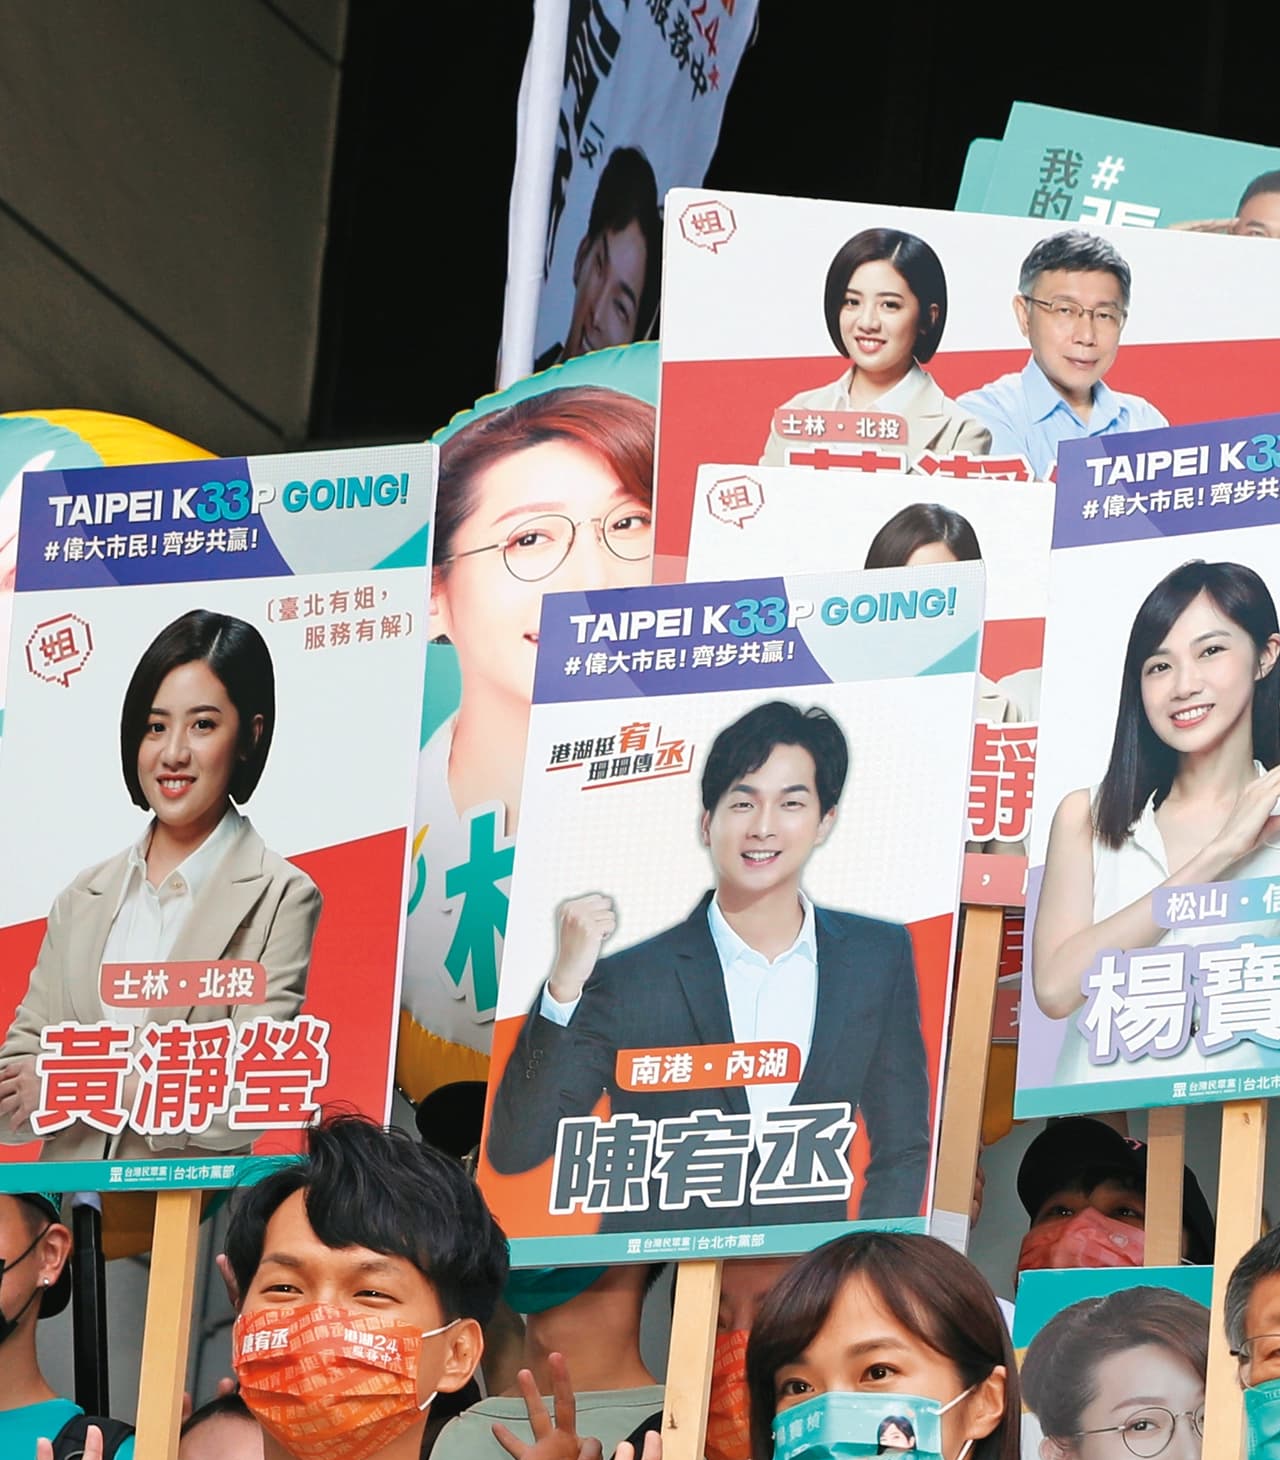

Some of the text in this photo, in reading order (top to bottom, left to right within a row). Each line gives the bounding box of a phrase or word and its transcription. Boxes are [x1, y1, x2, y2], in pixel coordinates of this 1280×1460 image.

[780, 411, 901, 441] 士林・北投
[1086, 445, 1210, 487] TAIPEI
[48, 487, 165, 528] TAIPEI
[282, 473, 410, 514] GOING!
[569, 607, 694, 645] TAIPEI
[820, 586, 958, 628] GOING!
[112, 968, 257, 1002] 士林・北投
[32, 1016, 332, 1136] 黃瀞瑩
[547, 1101, 860, 1216] 陳宥丞
